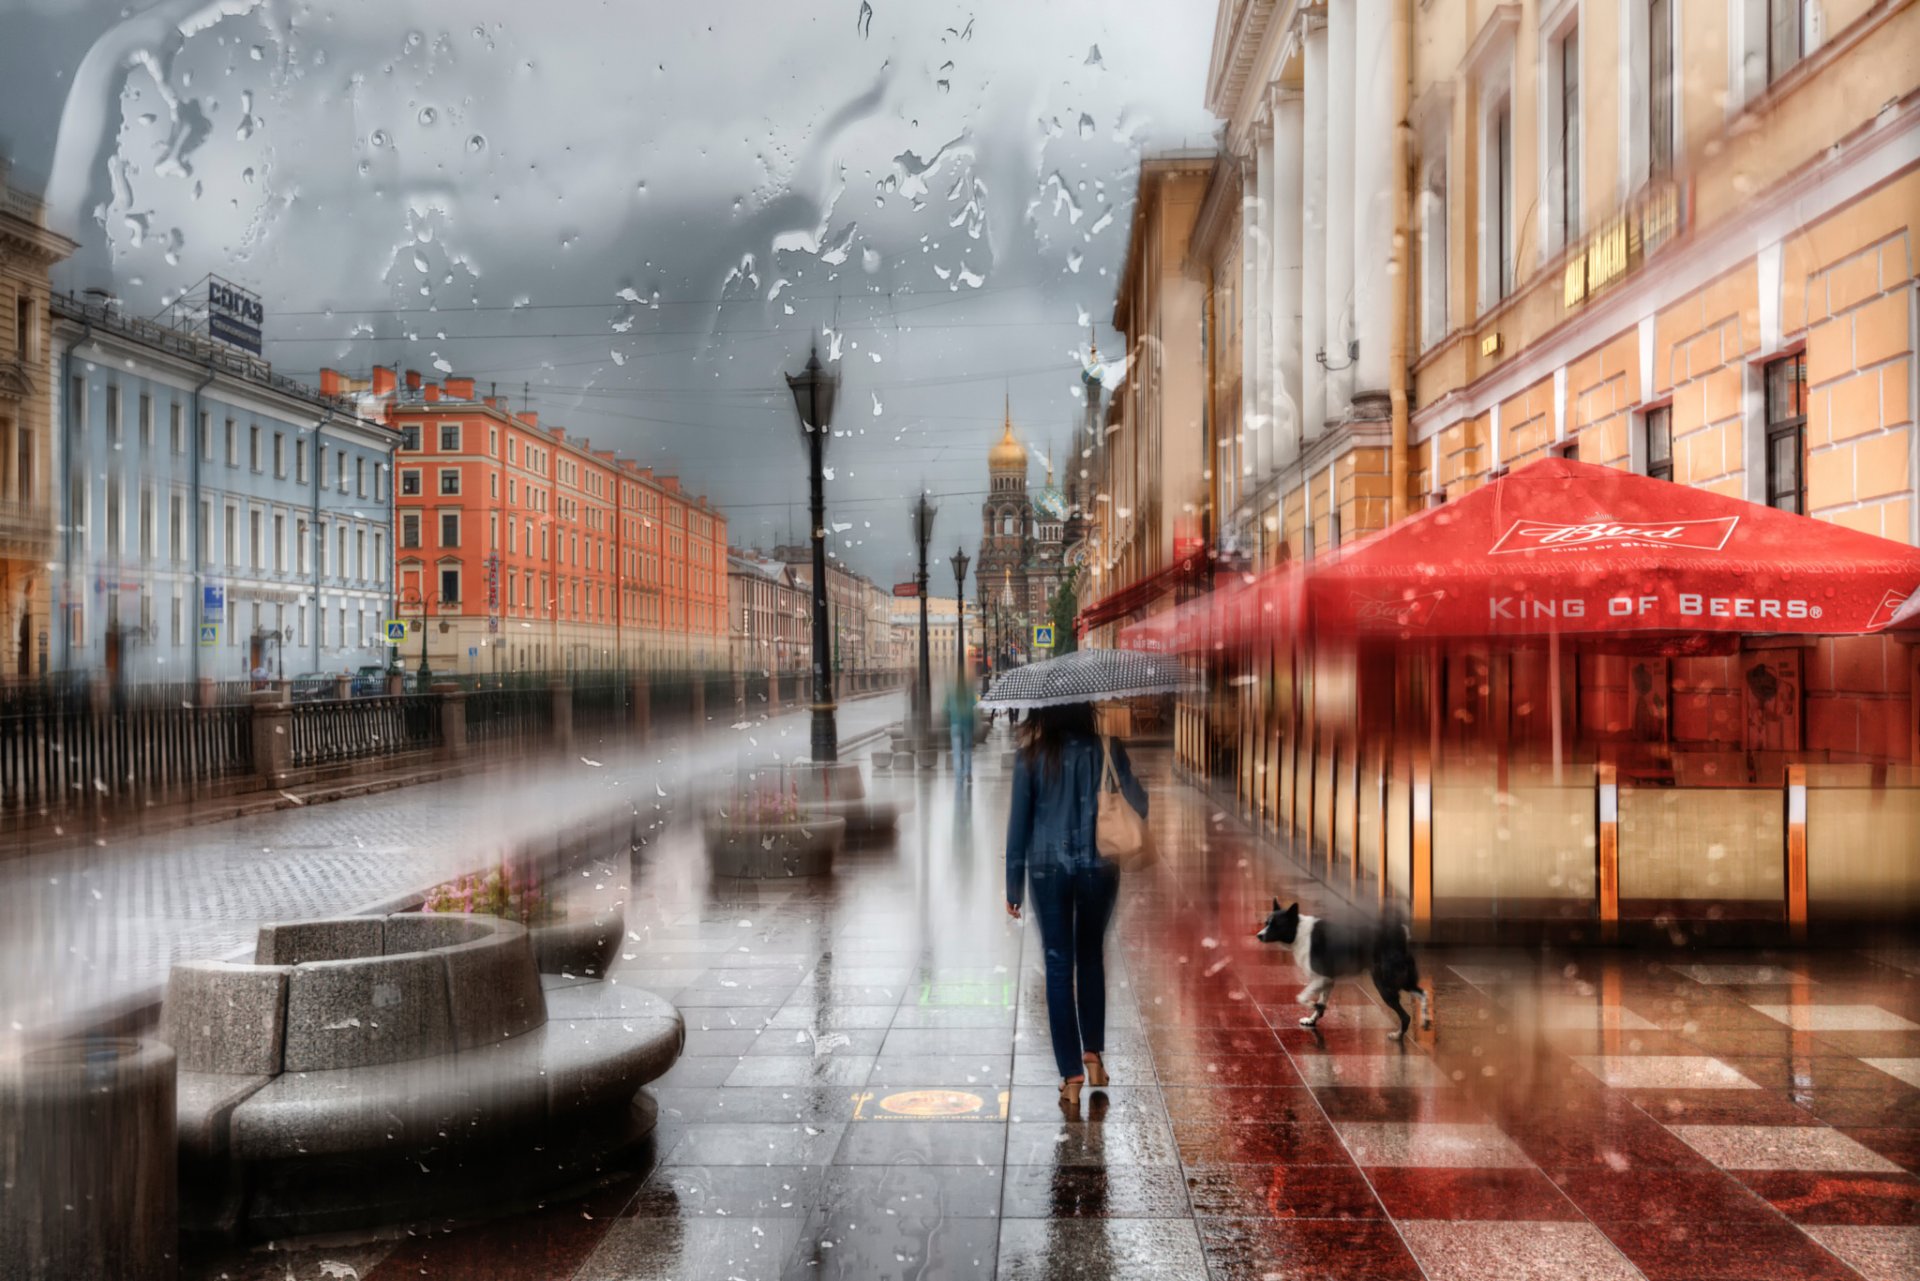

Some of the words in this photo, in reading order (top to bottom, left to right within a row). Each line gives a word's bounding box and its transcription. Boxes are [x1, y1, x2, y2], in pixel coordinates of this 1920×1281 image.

[1519, 522, 1686, 544] Bud
[1338, 563, 1459, 577] ЧРЕЗМЕРОЕ
[1489, 597, 1585, 620] KING
[1608, 596, 1658, 616] OF
